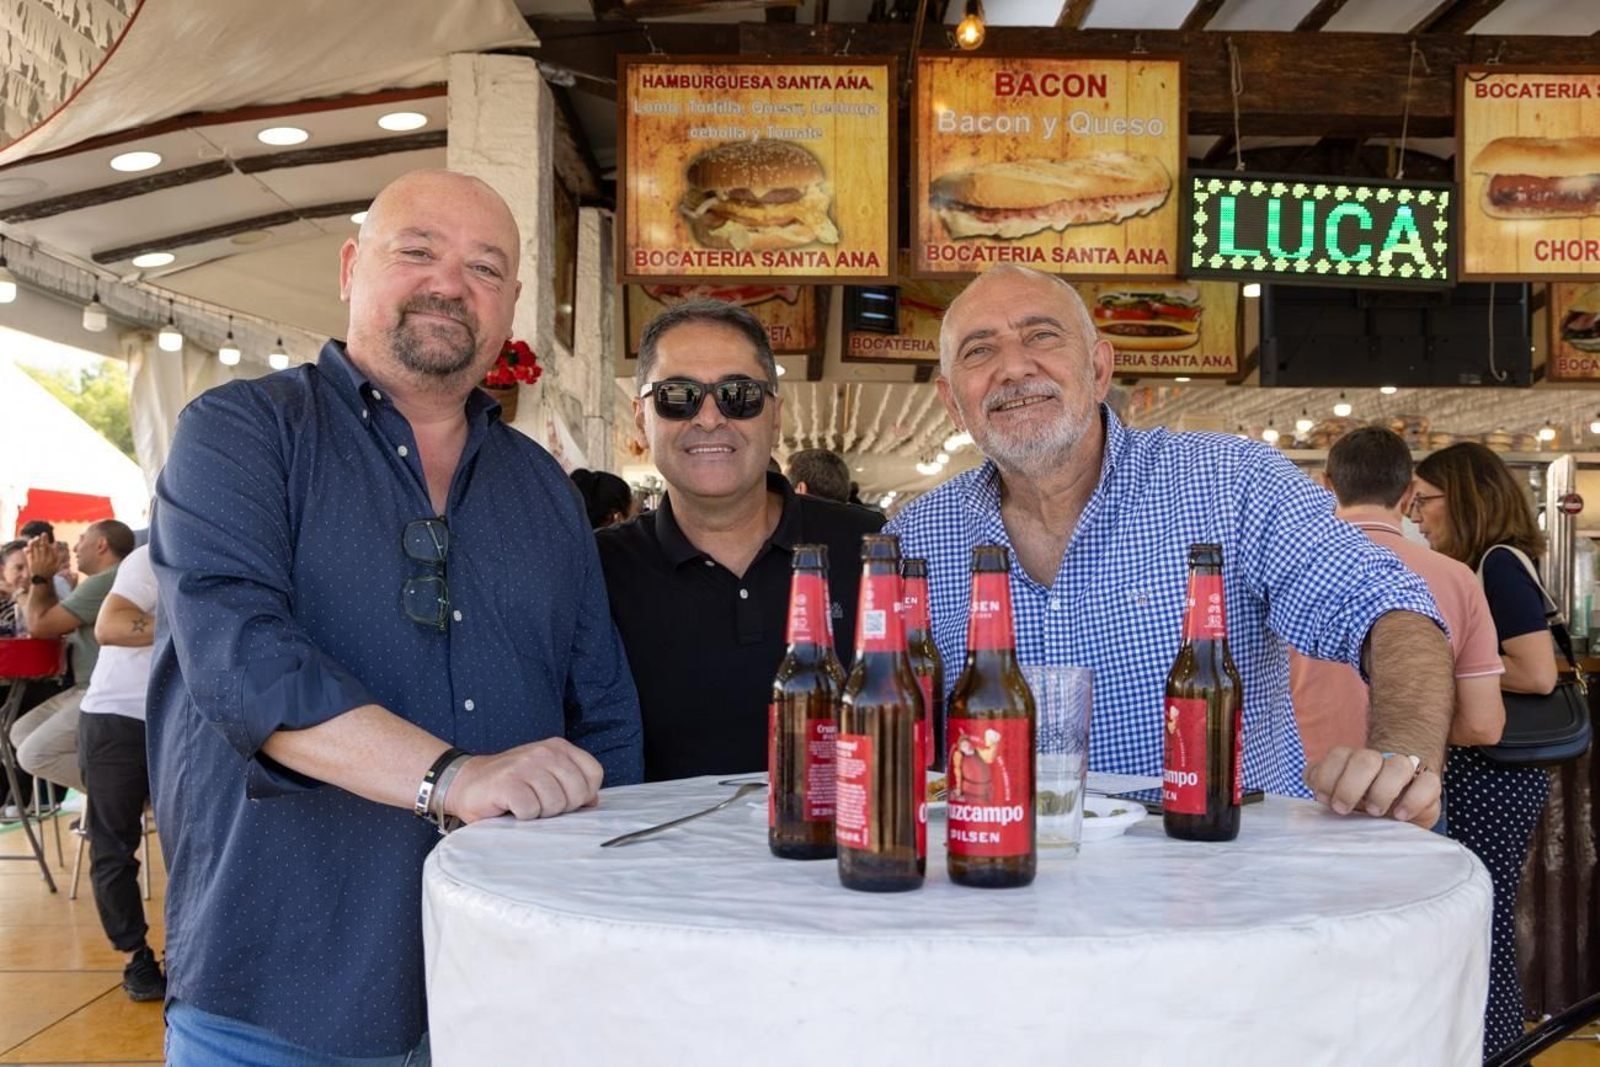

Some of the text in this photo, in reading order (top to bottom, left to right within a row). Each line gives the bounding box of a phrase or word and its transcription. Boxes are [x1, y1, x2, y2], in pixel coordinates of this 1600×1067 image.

[642, 75, 772, 89] HAMBURGUESA
[778, 75, 831, 90] SANTA
[995, 73, 1107, 98] BACON
[1475, 83, 1591, 98] BOCATERIA
[936, 109, 1165, 139] Bacon y Queso
[689, 126, 822, 142] cebolla y Tomate
[1219, 196, 1429, 270] LUCA
[635, 251, 880, 268] BOCATERIA SANTA ANA
[926, 245, 1168, 264] BOCATERIA SANTA ANA
[852, 337, 936, 352] BOCATERIA
[1150, 355, 1198, 367] SANTA
[1202, 355, 1233, 367] ANA
